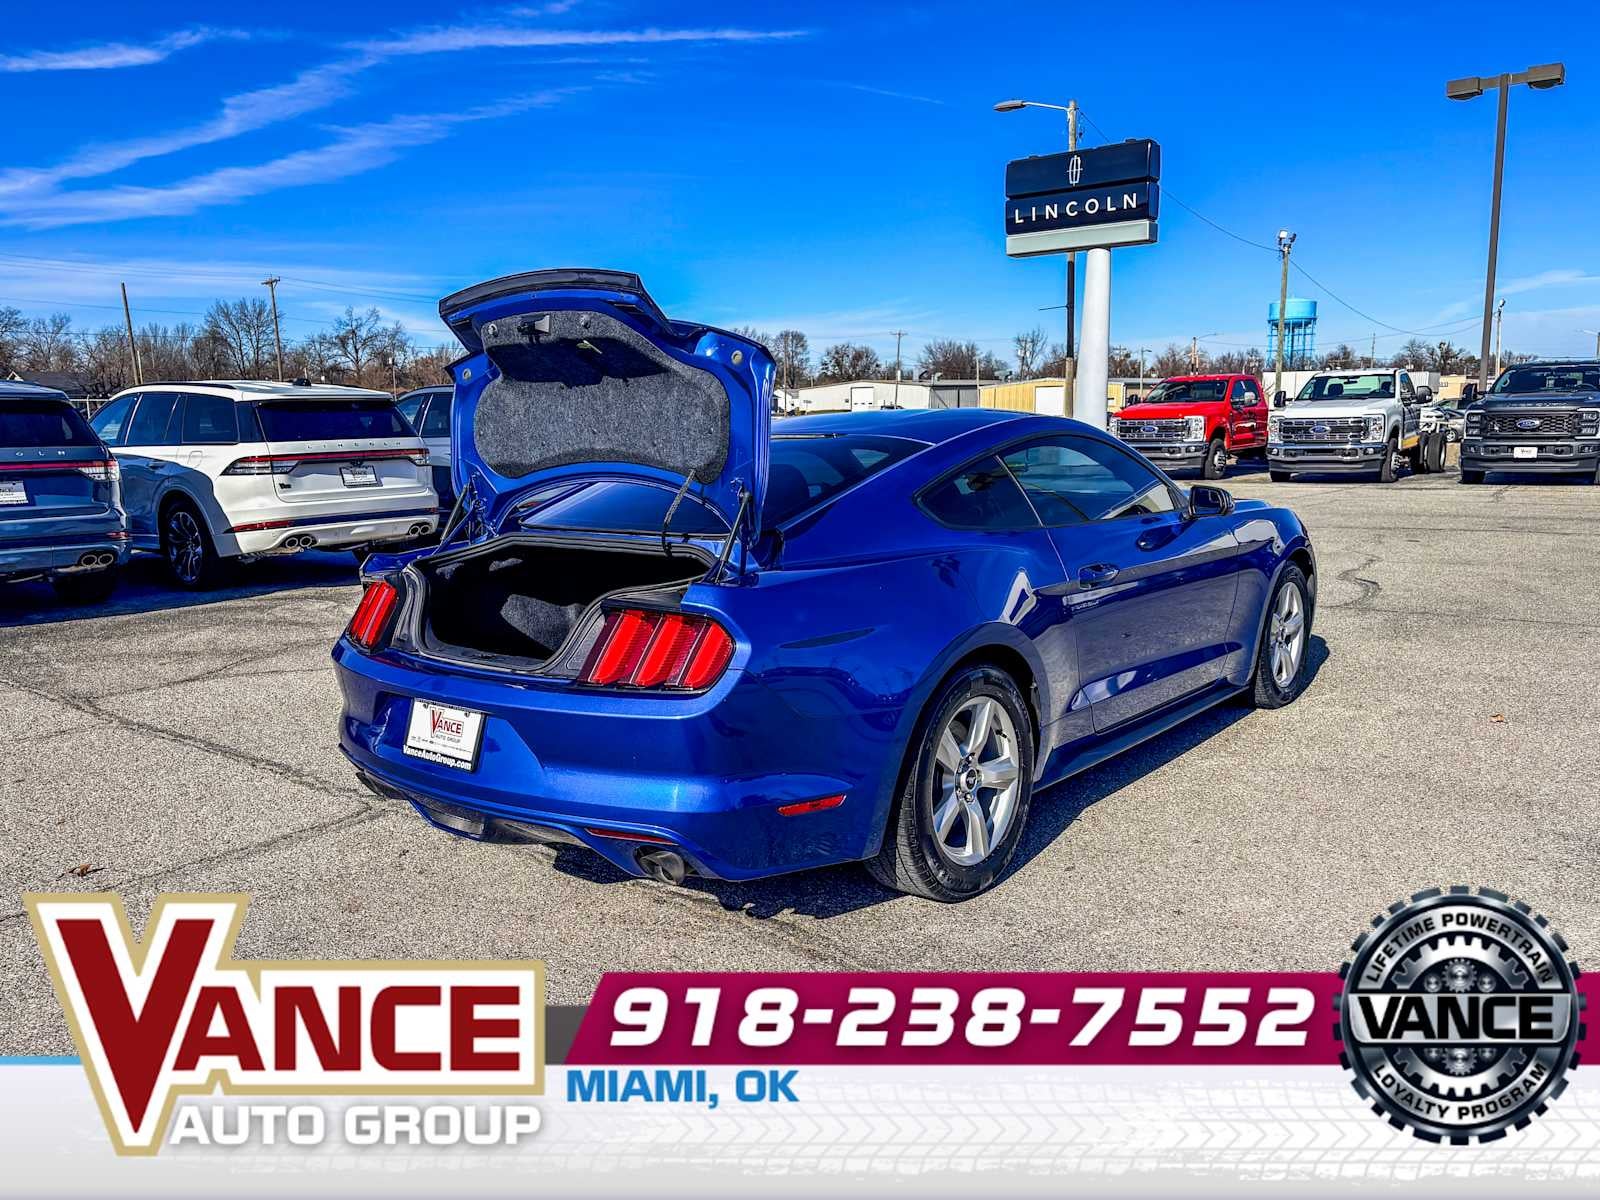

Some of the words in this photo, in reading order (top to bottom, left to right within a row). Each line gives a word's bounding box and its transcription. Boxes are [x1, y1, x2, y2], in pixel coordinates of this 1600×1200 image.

[1014, 192, 1137, 224] LINCOLN
[431, 709, 462, 734] VANCE
[403, 745, 472, 770] VanceAutoGroup.com
